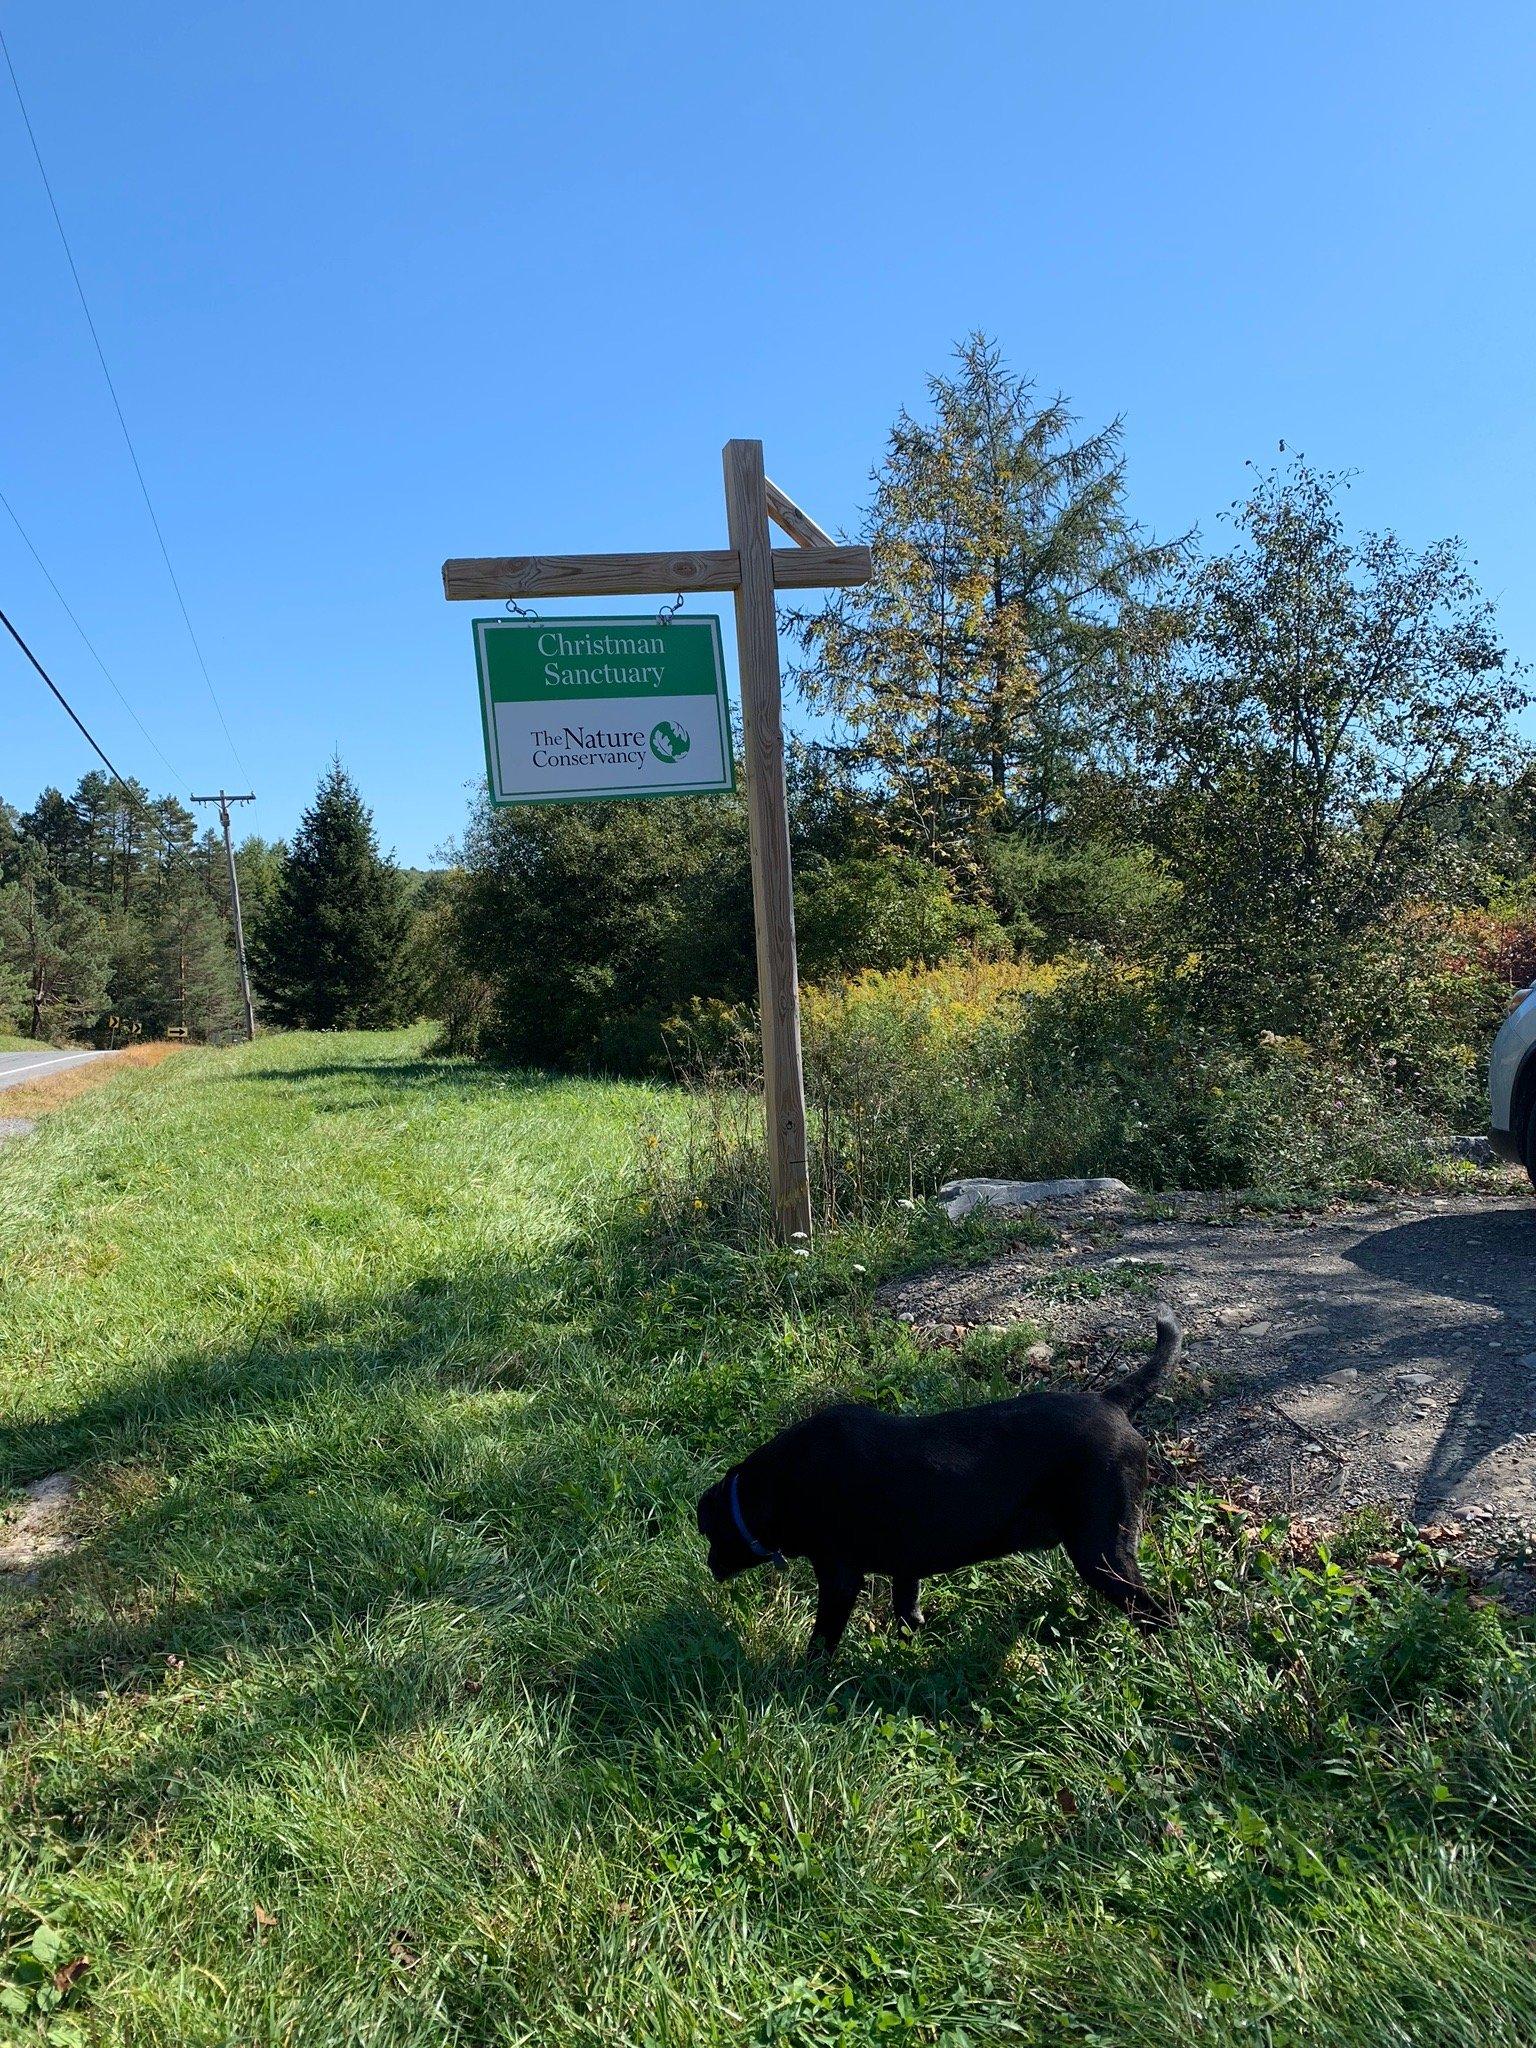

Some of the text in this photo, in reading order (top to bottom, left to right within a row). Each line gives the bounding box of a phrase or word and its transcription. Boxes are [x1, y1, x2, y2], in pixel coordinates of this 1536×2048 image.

[537, 633, 665, 657] Christman
[544, 662, 665, 687] Sanctuary
[531, 727, 646, 750] The Nature
[532, 750, 646, 769] Conservancy
